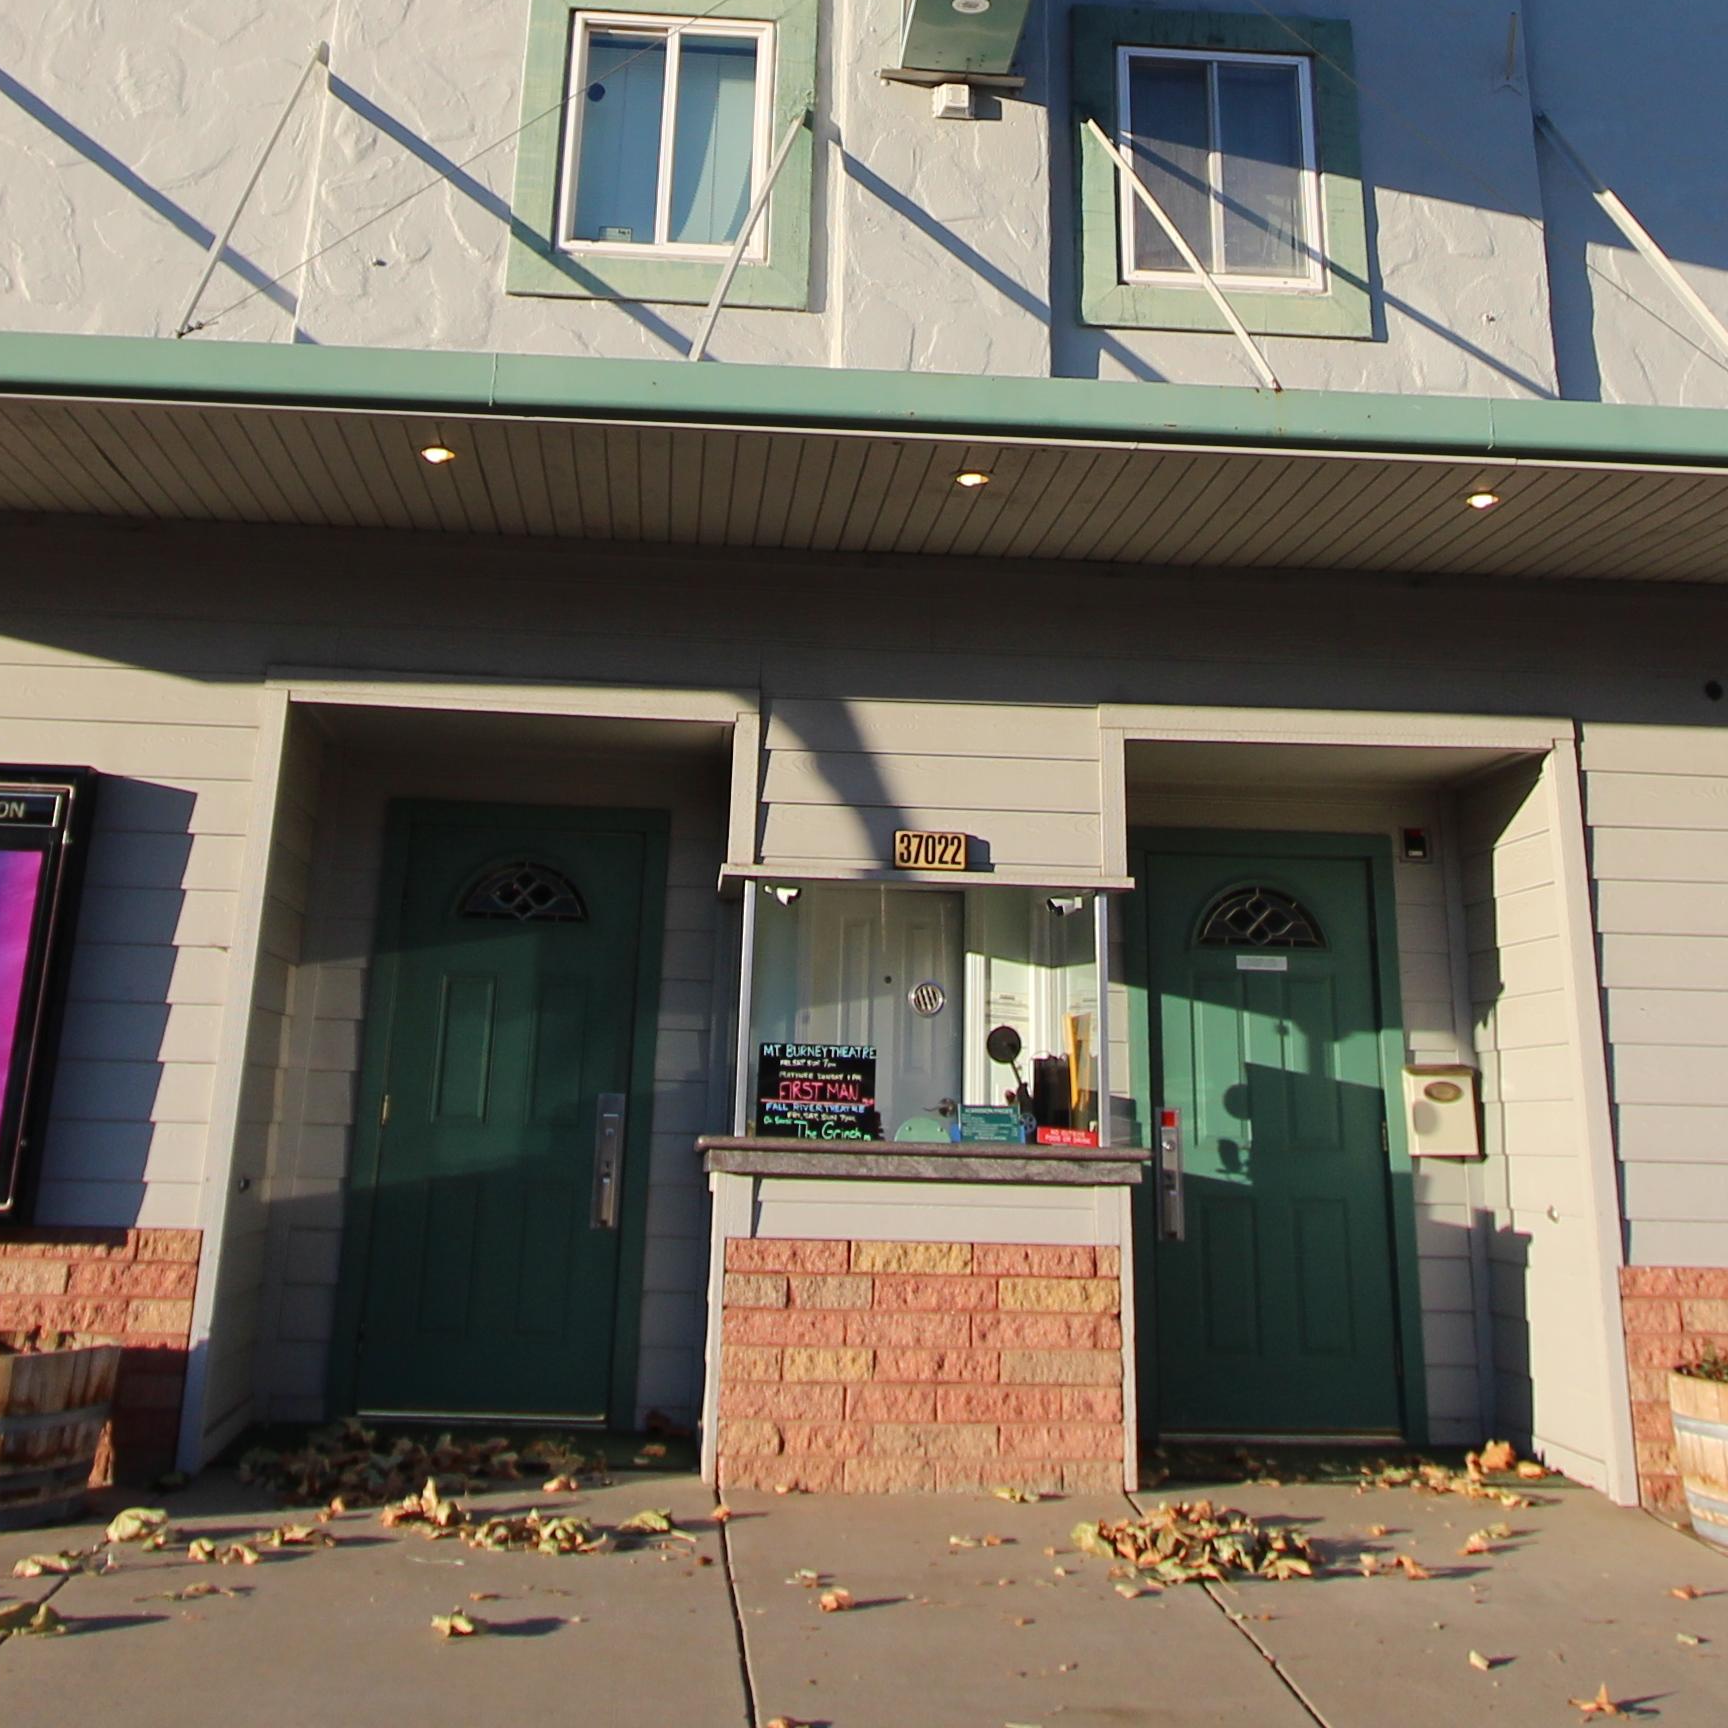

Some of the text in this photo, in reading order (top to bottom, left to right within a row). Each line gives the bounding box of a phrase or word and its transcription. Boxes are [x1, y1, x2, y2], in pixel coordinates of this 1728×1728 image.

[899, 833, 962, 865] 37022
[763, 1044, 877, 1059] MT BURNEY THEATRE
[779, 1080, 859, 1101] FIRST MAN
[765, 1102, 788, 1112] FALL
[793, 1103, 823, 1112] RIVER
[794, 1120, 861, 1140] The Grinch
